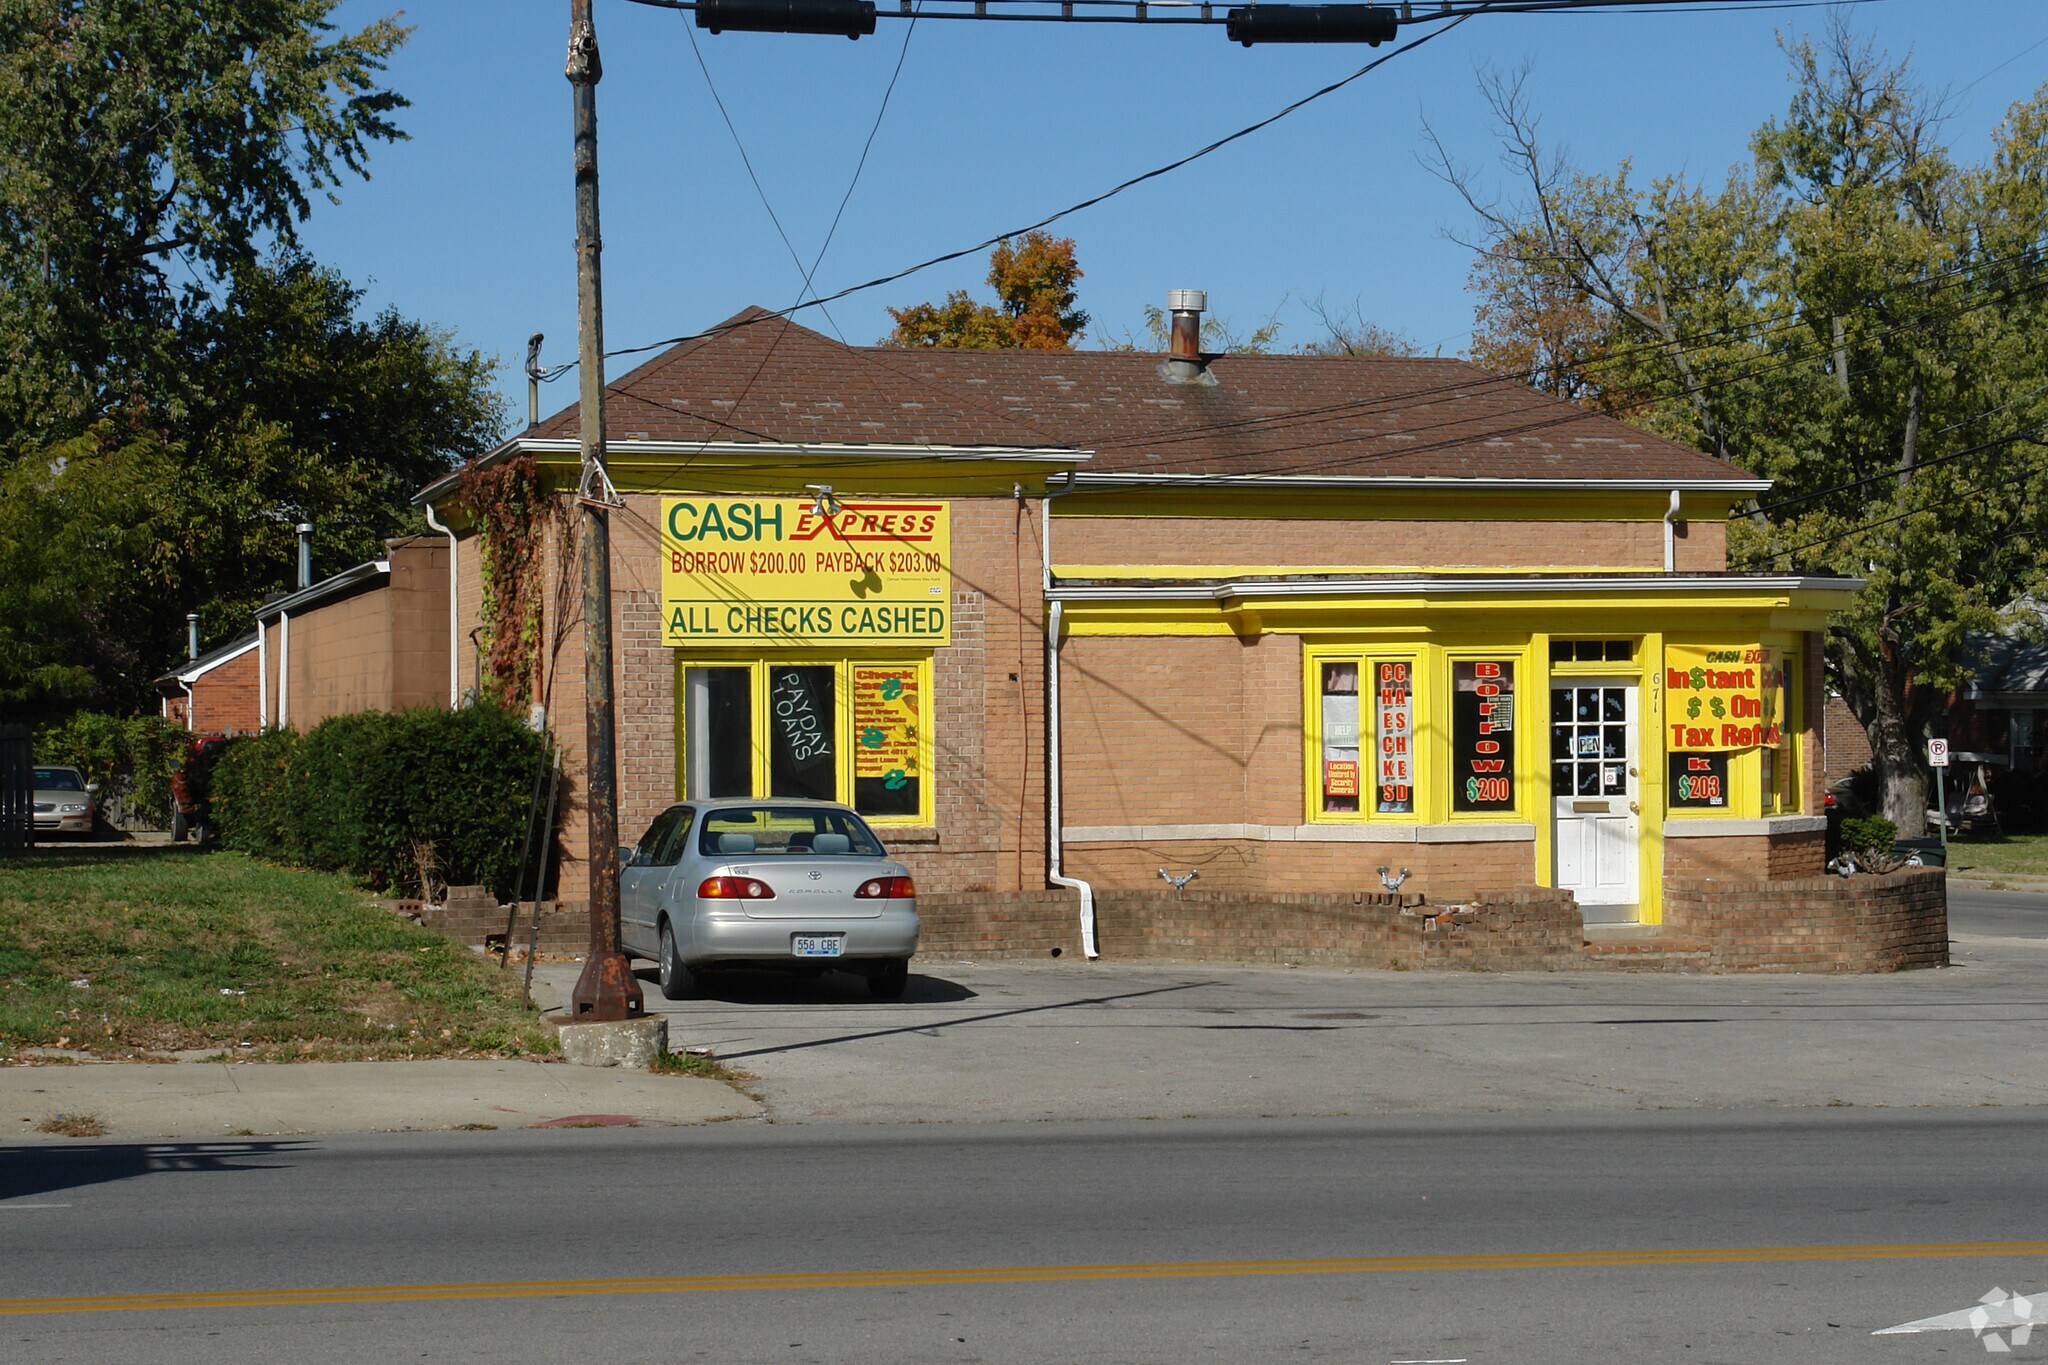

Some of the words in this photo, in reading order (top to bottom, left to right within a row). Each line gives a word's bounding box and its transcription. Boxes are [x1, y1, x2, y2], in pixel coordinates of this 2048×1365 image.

[668, 503, 782, 541] CASH
[793, 507, 938, 541] EXPRESS
[672, 552, 745, 574] BORROW
[750, 551, 805, 575] $200.00
[816, 551, 885, 573] PAYBACK
[889, 551, 941, 574] $203.00
[669, 607, 718, 633] ALL
[727, 607, 832, 633] CHECKS
[841, 607, 944, 633] CASHED
[1706, 651, 1740, 663] CASH
[856, 671, 914, 679] Check
[1652, 672, 1660, 713] 671
[782, 673, 831, 755] PAYDAY
[1731, 695, 1761, 718] On
[772, 687, 811, 760] LOANS
[1380, 664, 1394, 801] CHECKS
[1394, 664, 1408, 801] CASHED
[1670, 724, 1715, 747] Tax
[1330, 762, 1354, 770] Location
[1330, 779, 1353, 787] Security
[1466, 777, 1509, 802] $200
[1679, 775, 1720, 800] $203
[798, 940, 815, 950] 558
[821, 940, 838, 950] CBE
